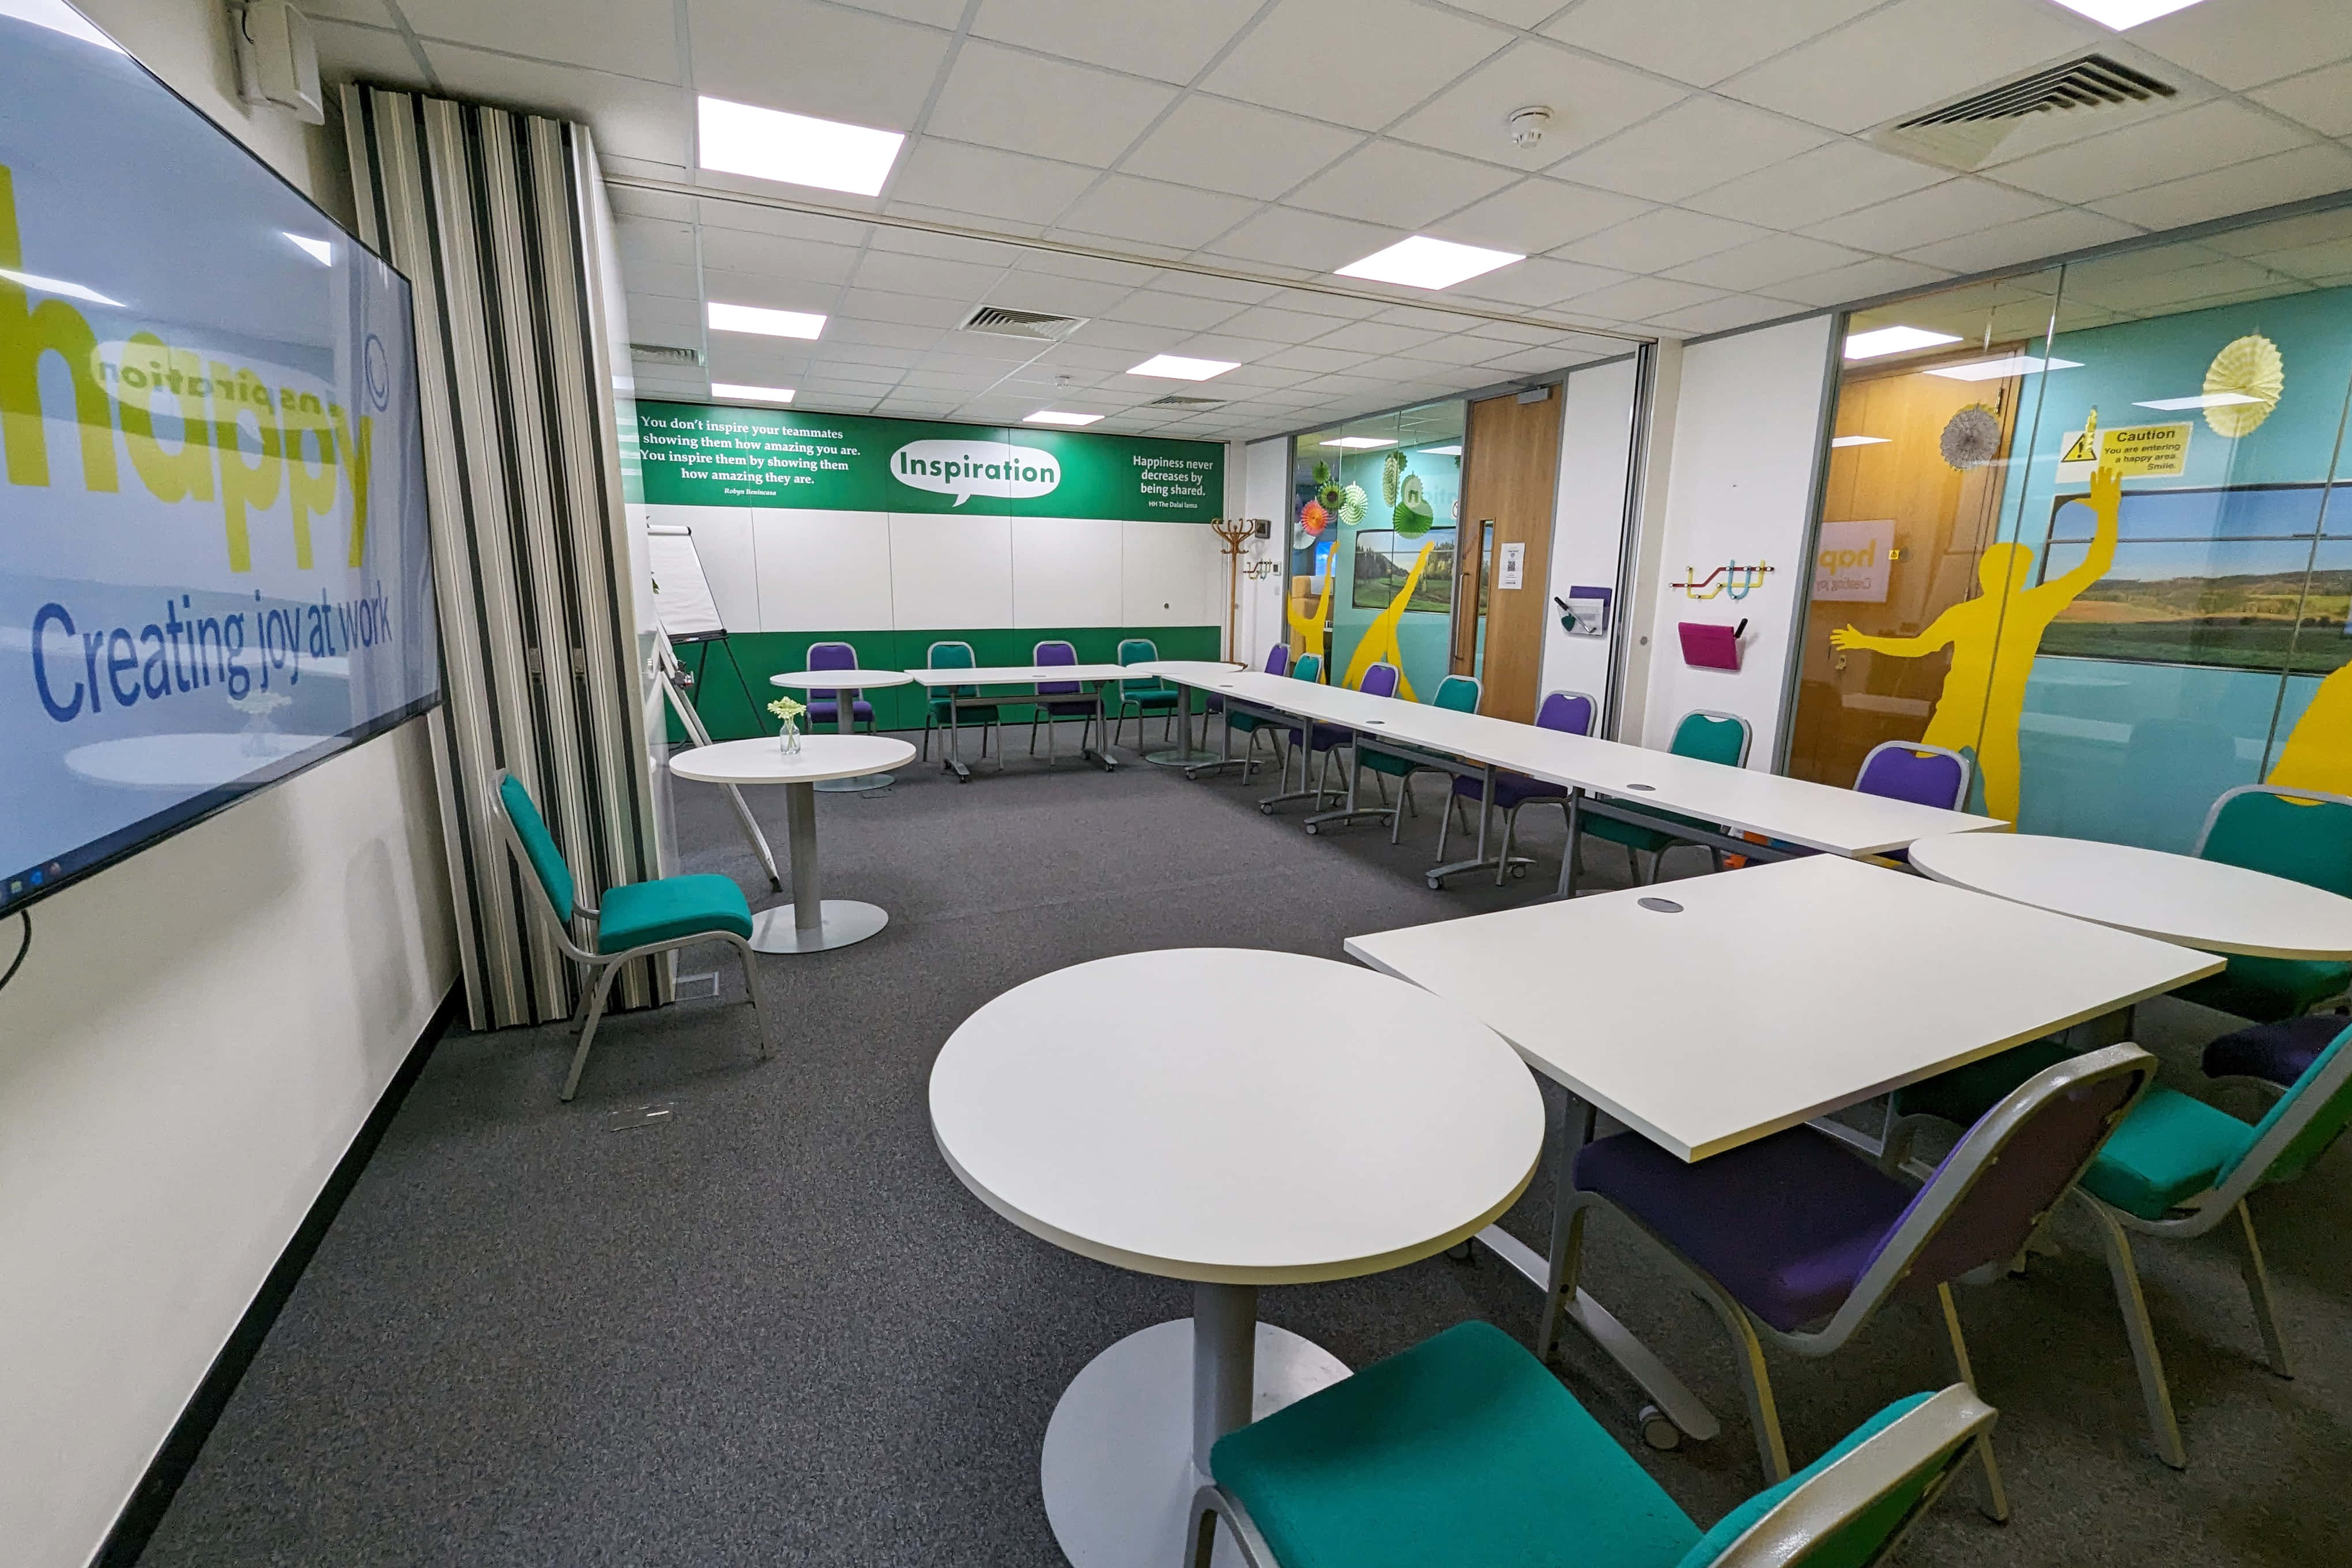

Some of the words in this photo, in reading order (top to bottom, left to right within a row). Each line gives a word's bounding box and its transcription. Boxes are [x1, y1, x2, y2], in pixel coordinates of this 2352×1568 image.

[0, 164, 374, 572] happy
[641, 416, 667, 428] You
[670, 418, 703, 430] don’t
[706, 420, 749, 435] inspire
[752, 425, 779, 436] your
[782, 427, 843, 439] teammates
[2117, 429, 2175, 442] Caution
[643, 434, 698, 449] showing
[701, 436, 732, 448] them
[736, 438, 761, 450] how
[764, 442, 814, 455] amazing
[816, 446, 838, 456] you
[840, 447, 860, 455] are.
[2141, 443, 2181, 452] entering
[640, 450, 665, 461] You
[669, 451, 713, 465] inspire
[715, 454, 747, 465] them
[749, 455, 764, 469] by
[768, 457, 817, 472] showing
[820, 459, 849, 470] them
[1133, 455, 1183, 469] Happiness
[1186, 461, 1213, 470] never
[2124, 455, 2152, 463] happy
[2147, 462, 2176, 470] Smile.
[900, 451, 1054, 484] Inspiration
[681, 468, 708, 479] how
[711, 471, 763, 484] amazing
[766, 472, 791, 485] they
[794, 476, 815, 484] are.
[1141, 469, 1189, 482] decreases
[1191, 472, 1203, 485] by
[724, 488, 745, 496] Robyn
[1141, 483, 1169, 497] being
[1171, 484, 1205, 496] shared.
[32, 594, 251, 723] Creating
[255, 589, 300, 693] joy
[307, 587, 336, 658] at
[338, 579, 393, 652] work
